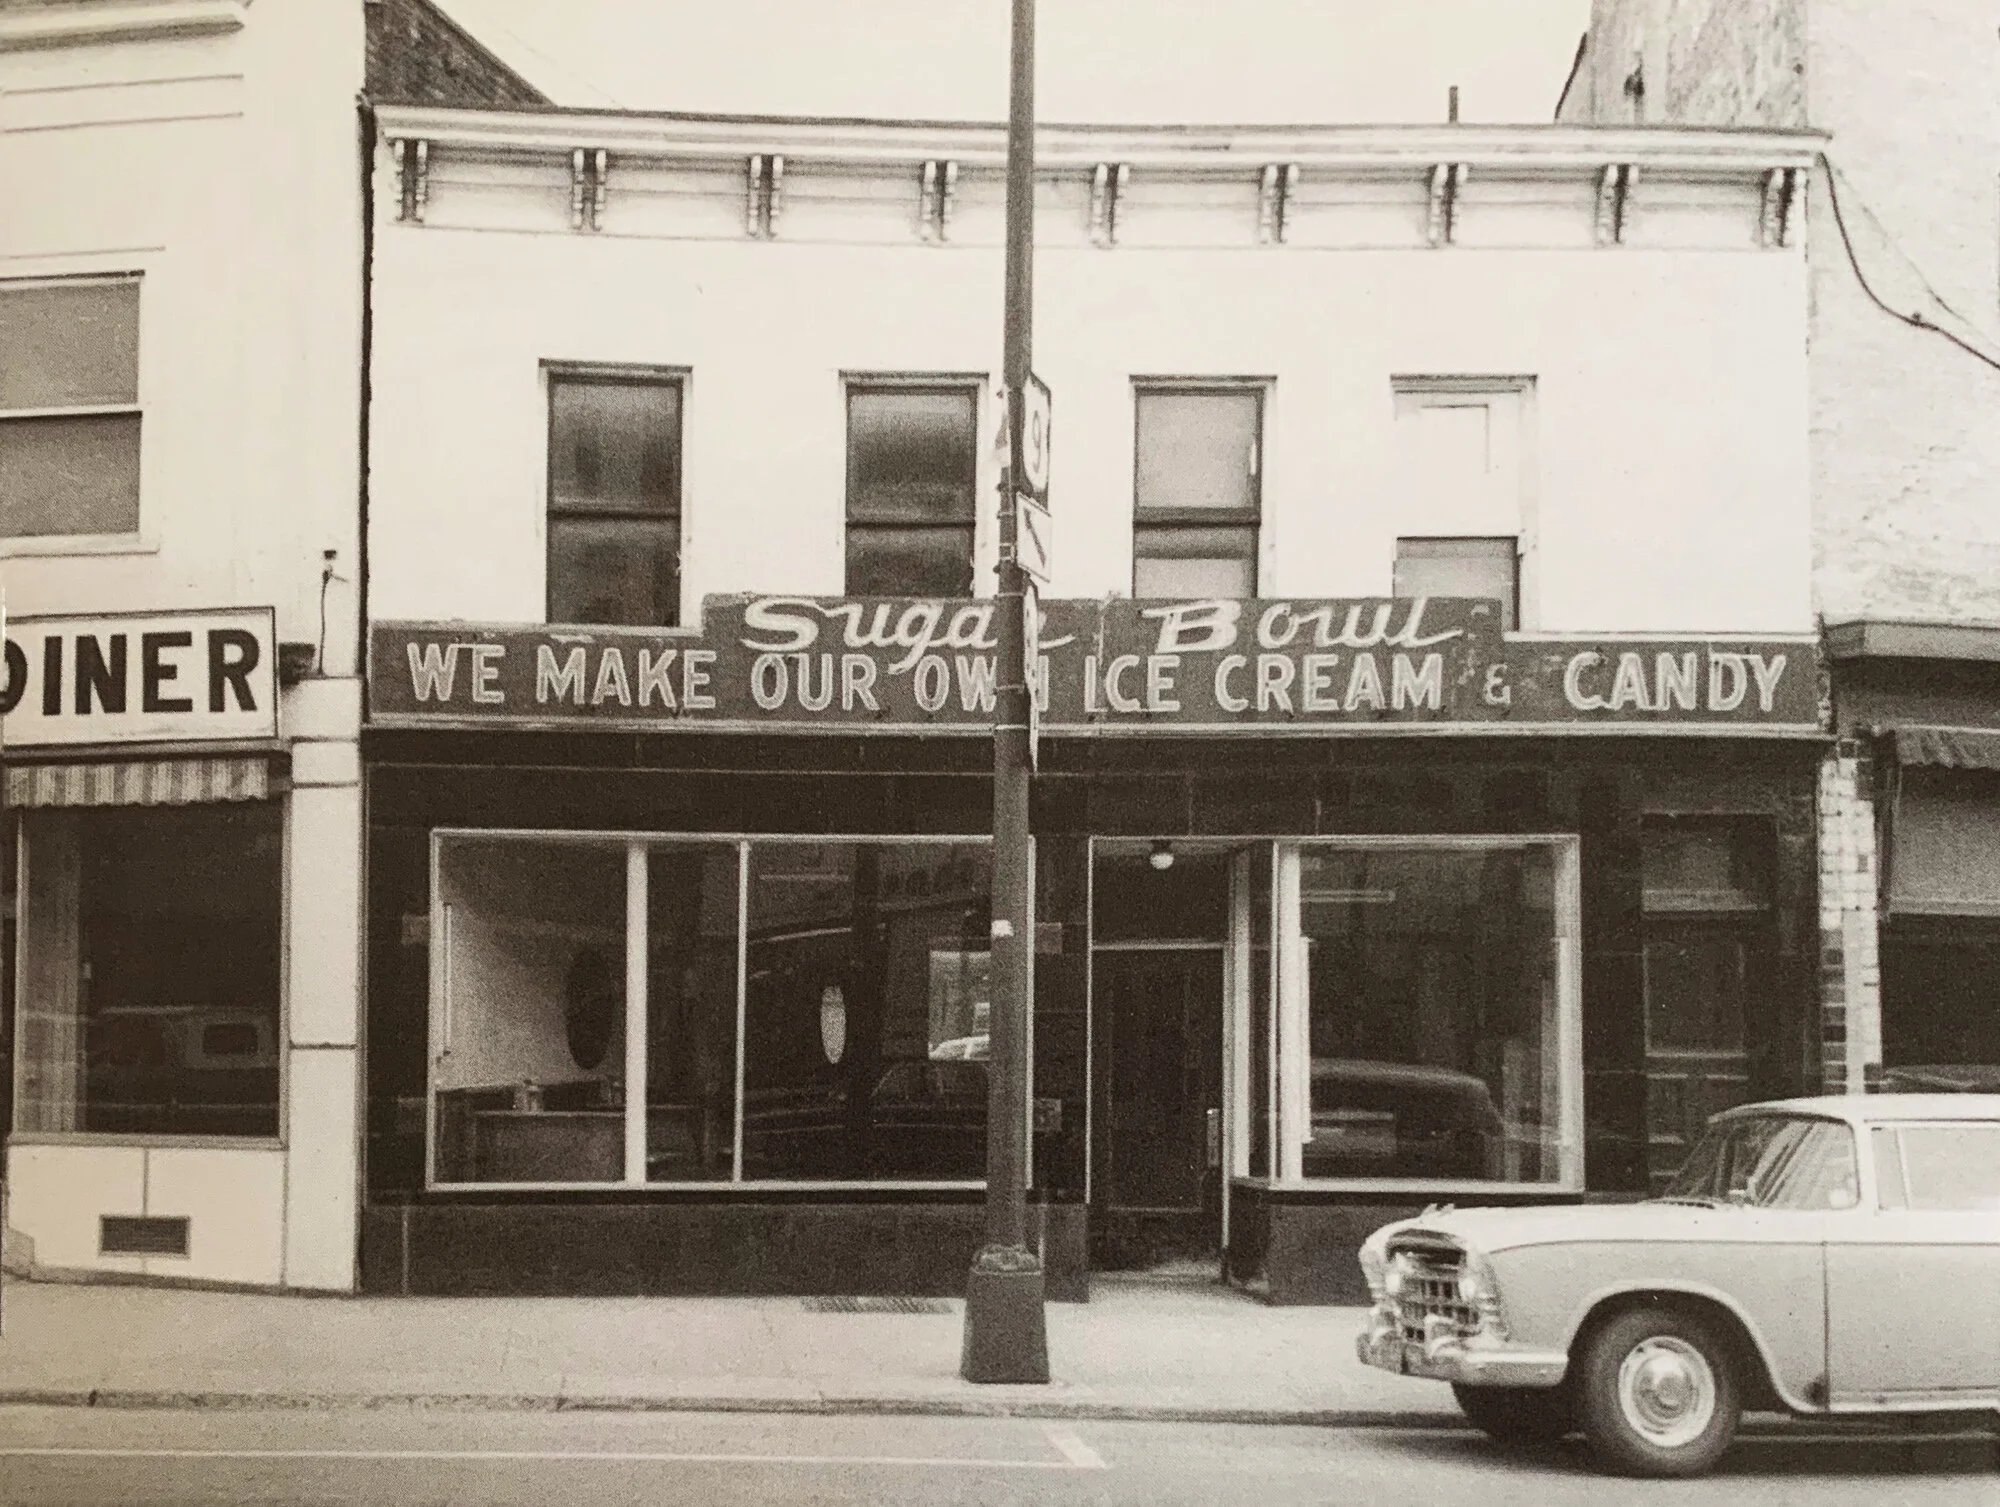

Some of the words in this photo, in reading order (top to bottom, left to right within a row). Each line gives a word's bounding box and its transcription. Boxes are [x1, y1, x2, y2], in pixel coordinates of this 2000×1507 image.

[1141, 596, 1463, 653] Bowl
[406, 642, 505, 703] WE
[536, 644, 717, 708] MAKE
[751, 653, 881, 711] OUR
[1084, 653, 1181, 713] ICE
[1215, 652, 1443, 712] CREAM
[1484, 663, 1512, 706] &
[1563, 651, 1787, 712] CANDY
